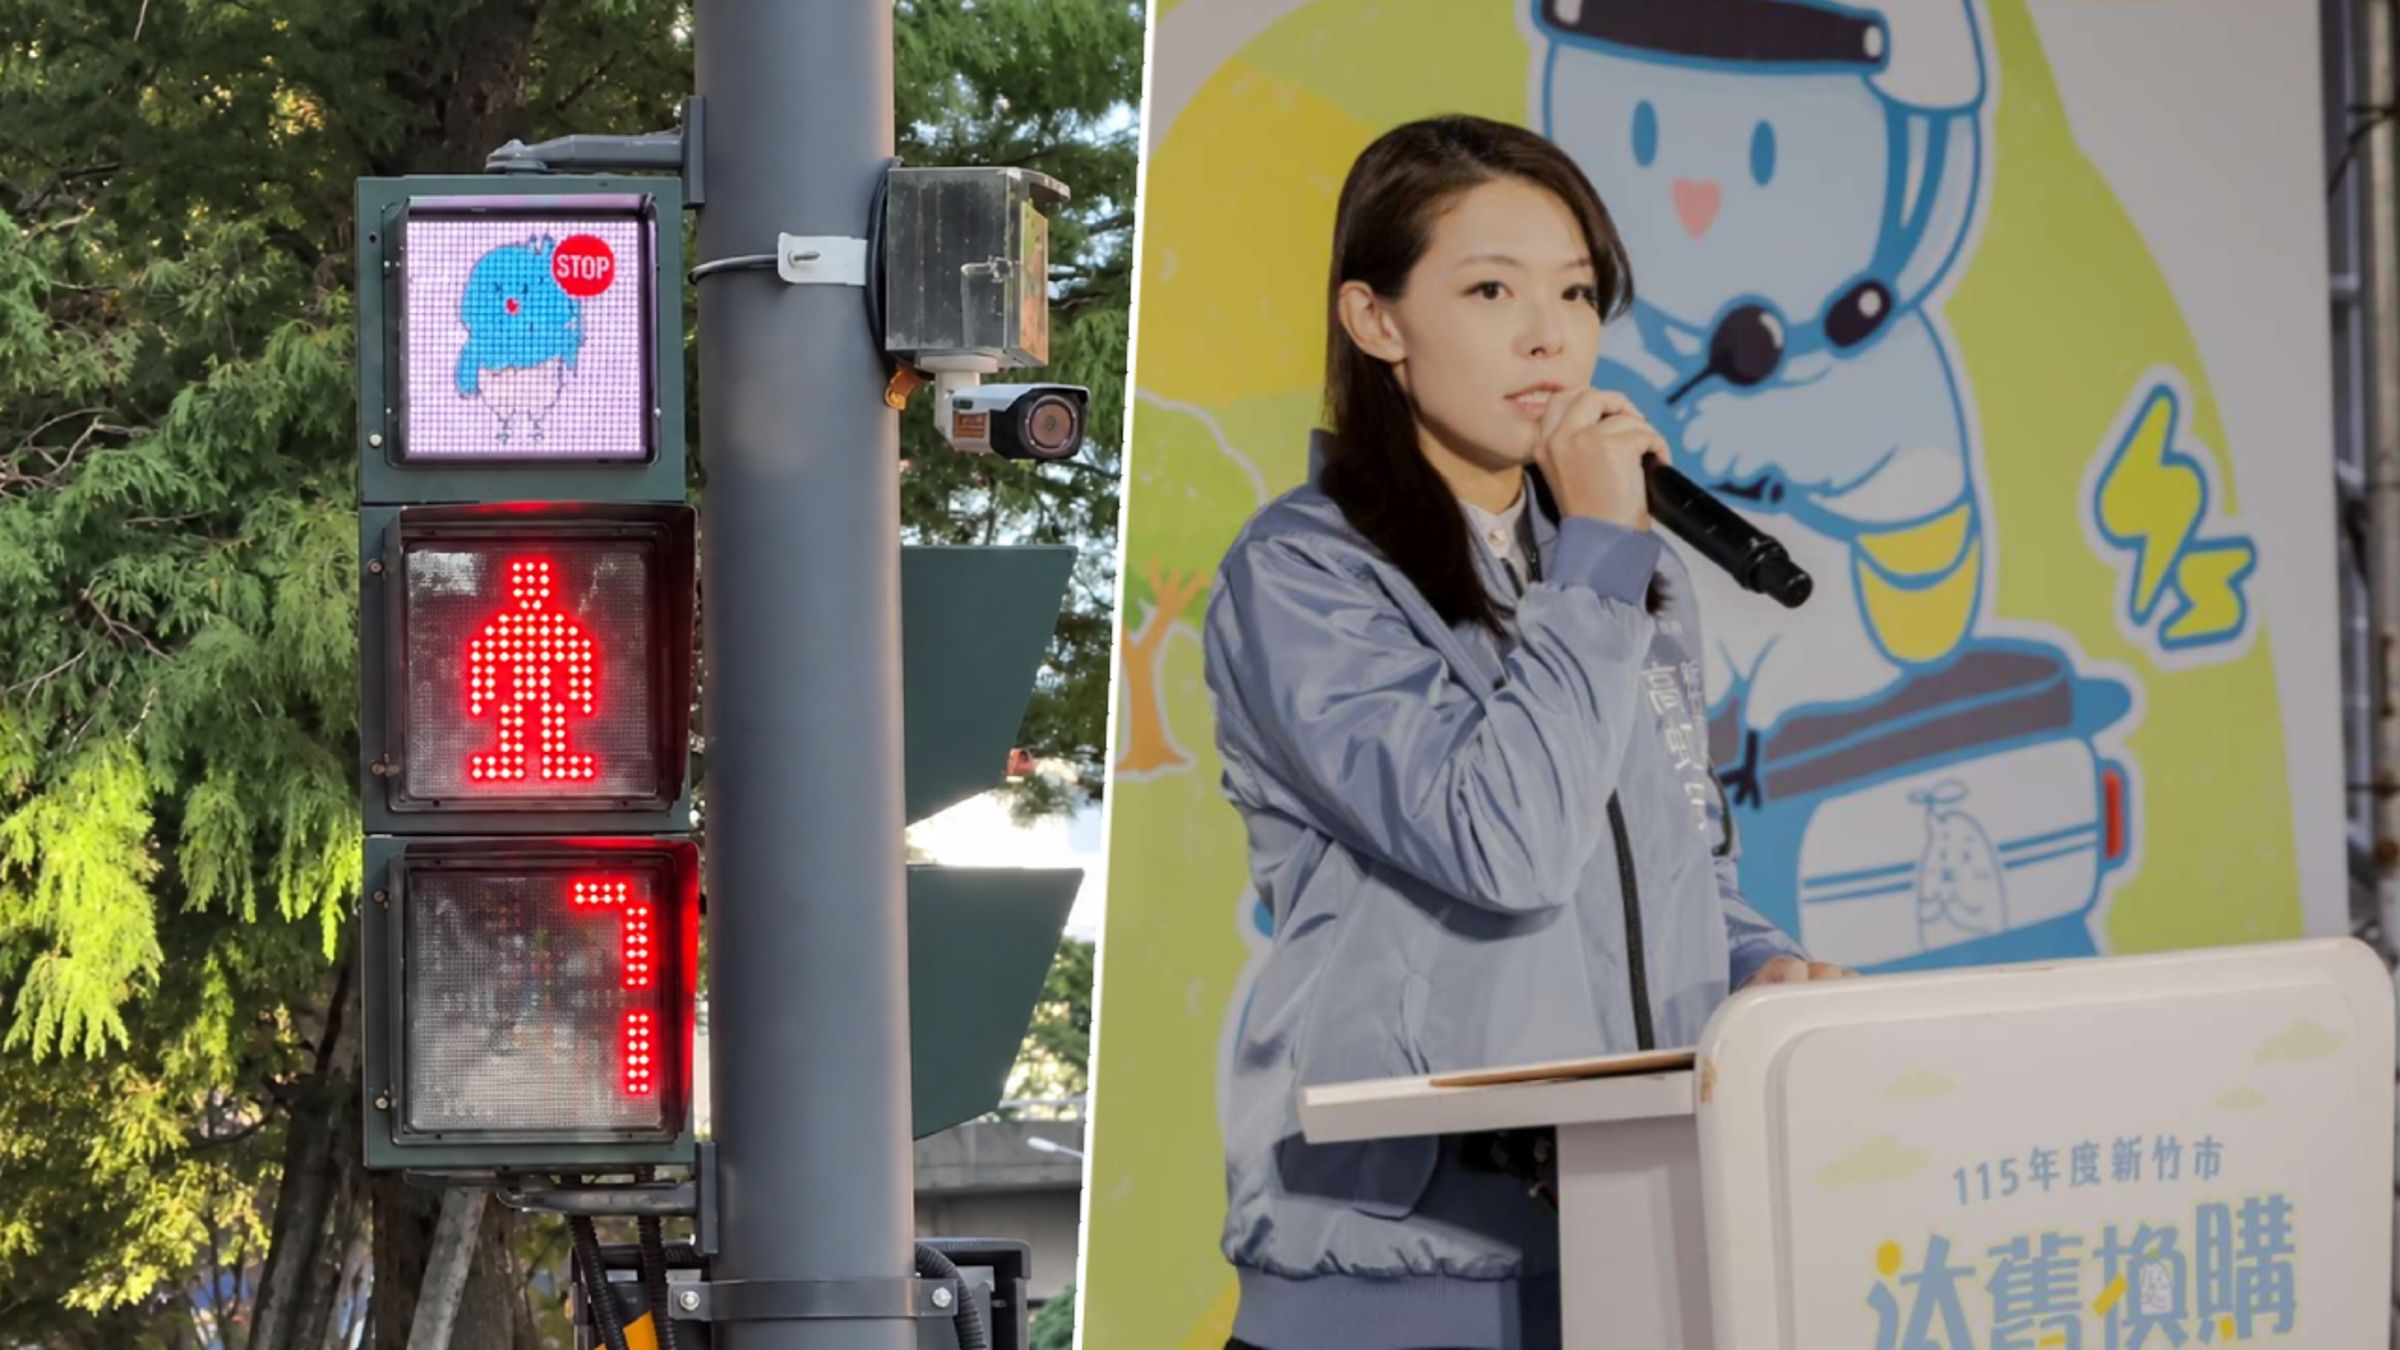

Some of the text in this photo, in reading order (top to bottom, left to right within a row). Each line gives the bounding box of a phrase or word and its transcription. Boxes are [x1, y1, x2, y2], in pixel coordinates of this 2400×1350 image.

[556, 254, 610, 280] STOP
[572, 879, 653, 1096] 7
[1953, 1134, 2225, 1206] 115年度新竹市
[1866, 1193, 2297, 1350] 汰舊換購
